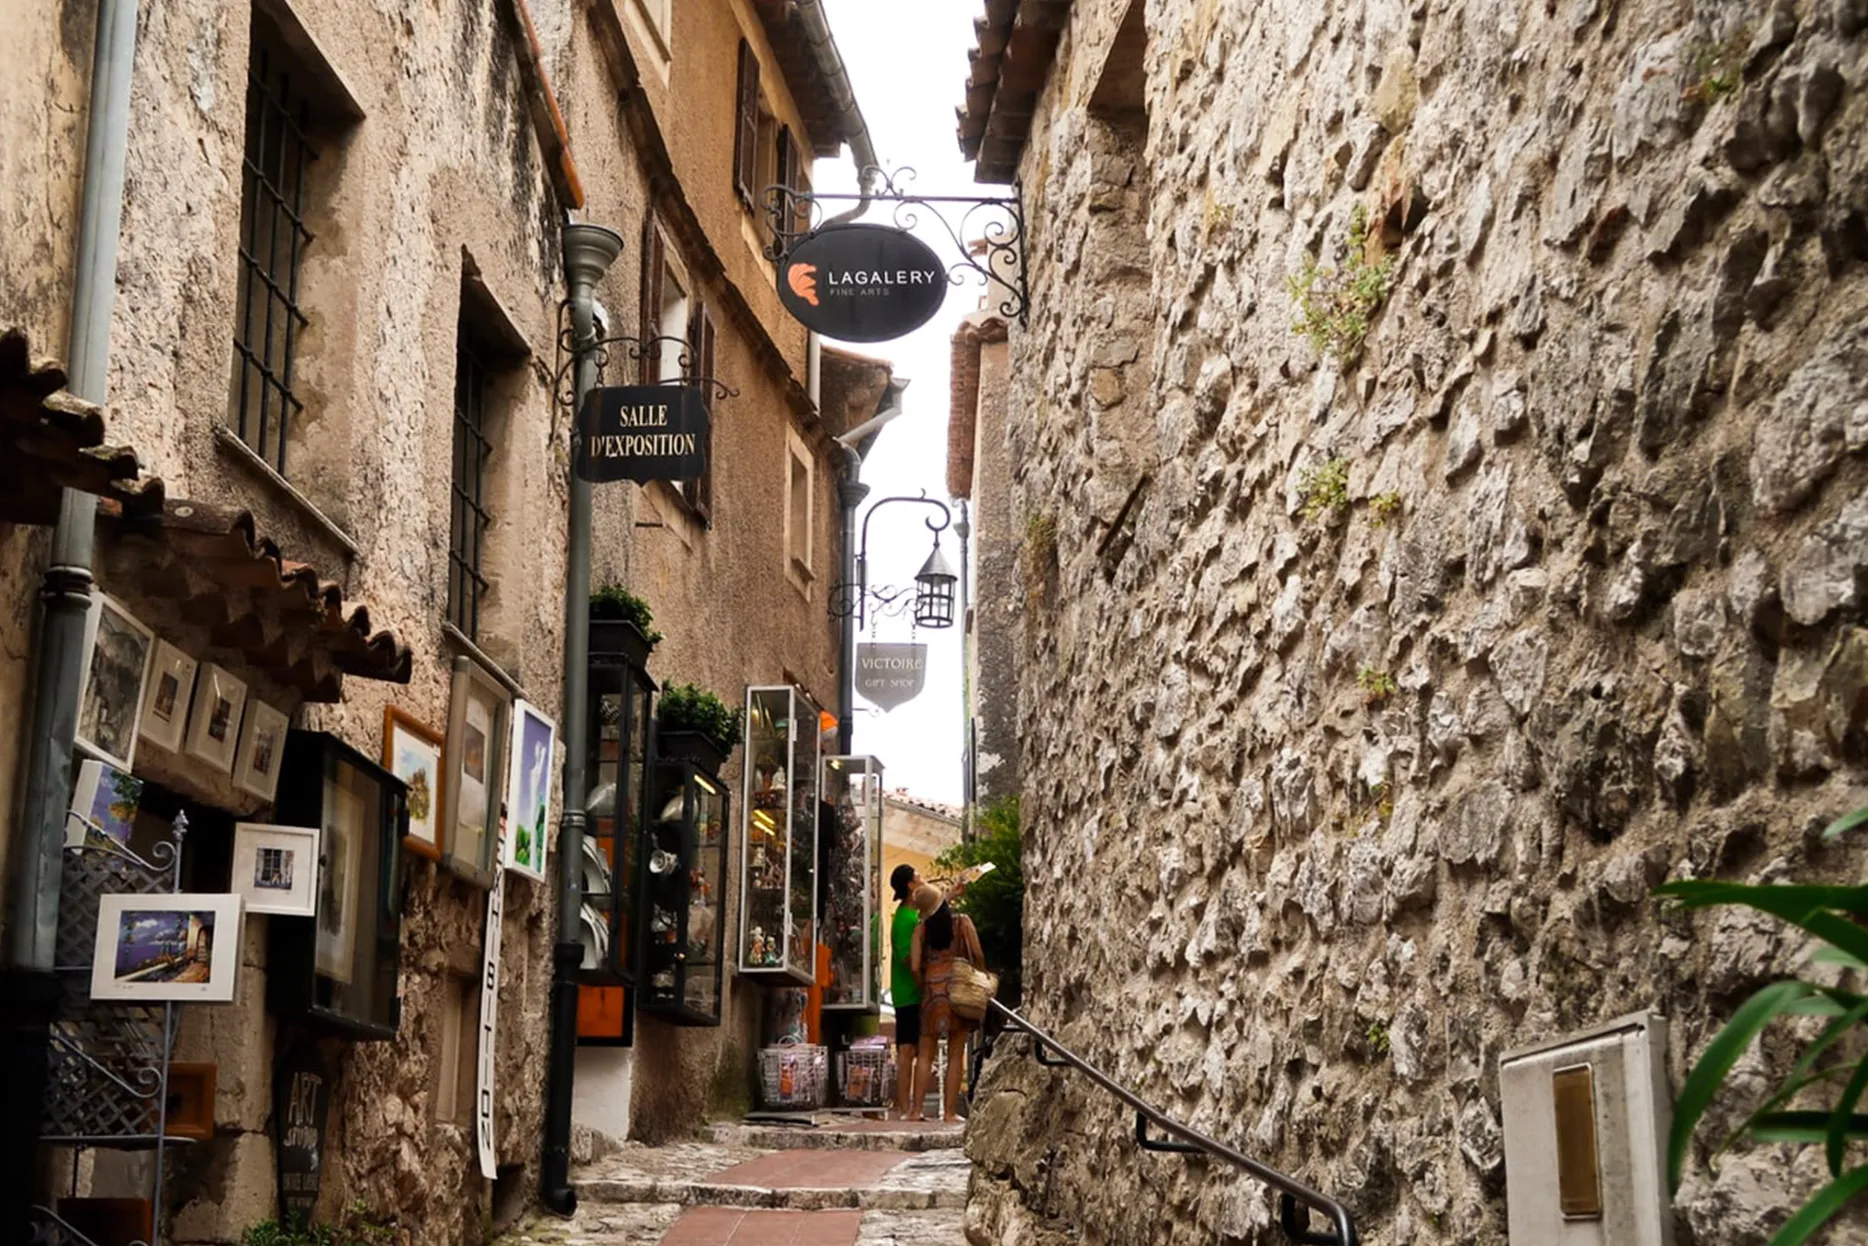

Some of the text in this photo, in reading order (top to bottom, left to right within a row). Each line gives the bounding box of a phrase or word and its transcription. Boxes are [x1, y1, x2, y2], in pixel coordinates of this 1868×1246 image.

[828, 270, 935, 285] LAGALERY
[829, 288, 890, 296] FINE ARTS
[619, 404, 668, 427] SALLE
[590, 433, 696, 458] D'EXPOSITION
[861, 658, 923, 669] VICTOIRE
[864, 679, 886, 688] GIFT
[288, 1072, 322, 1126] ART
